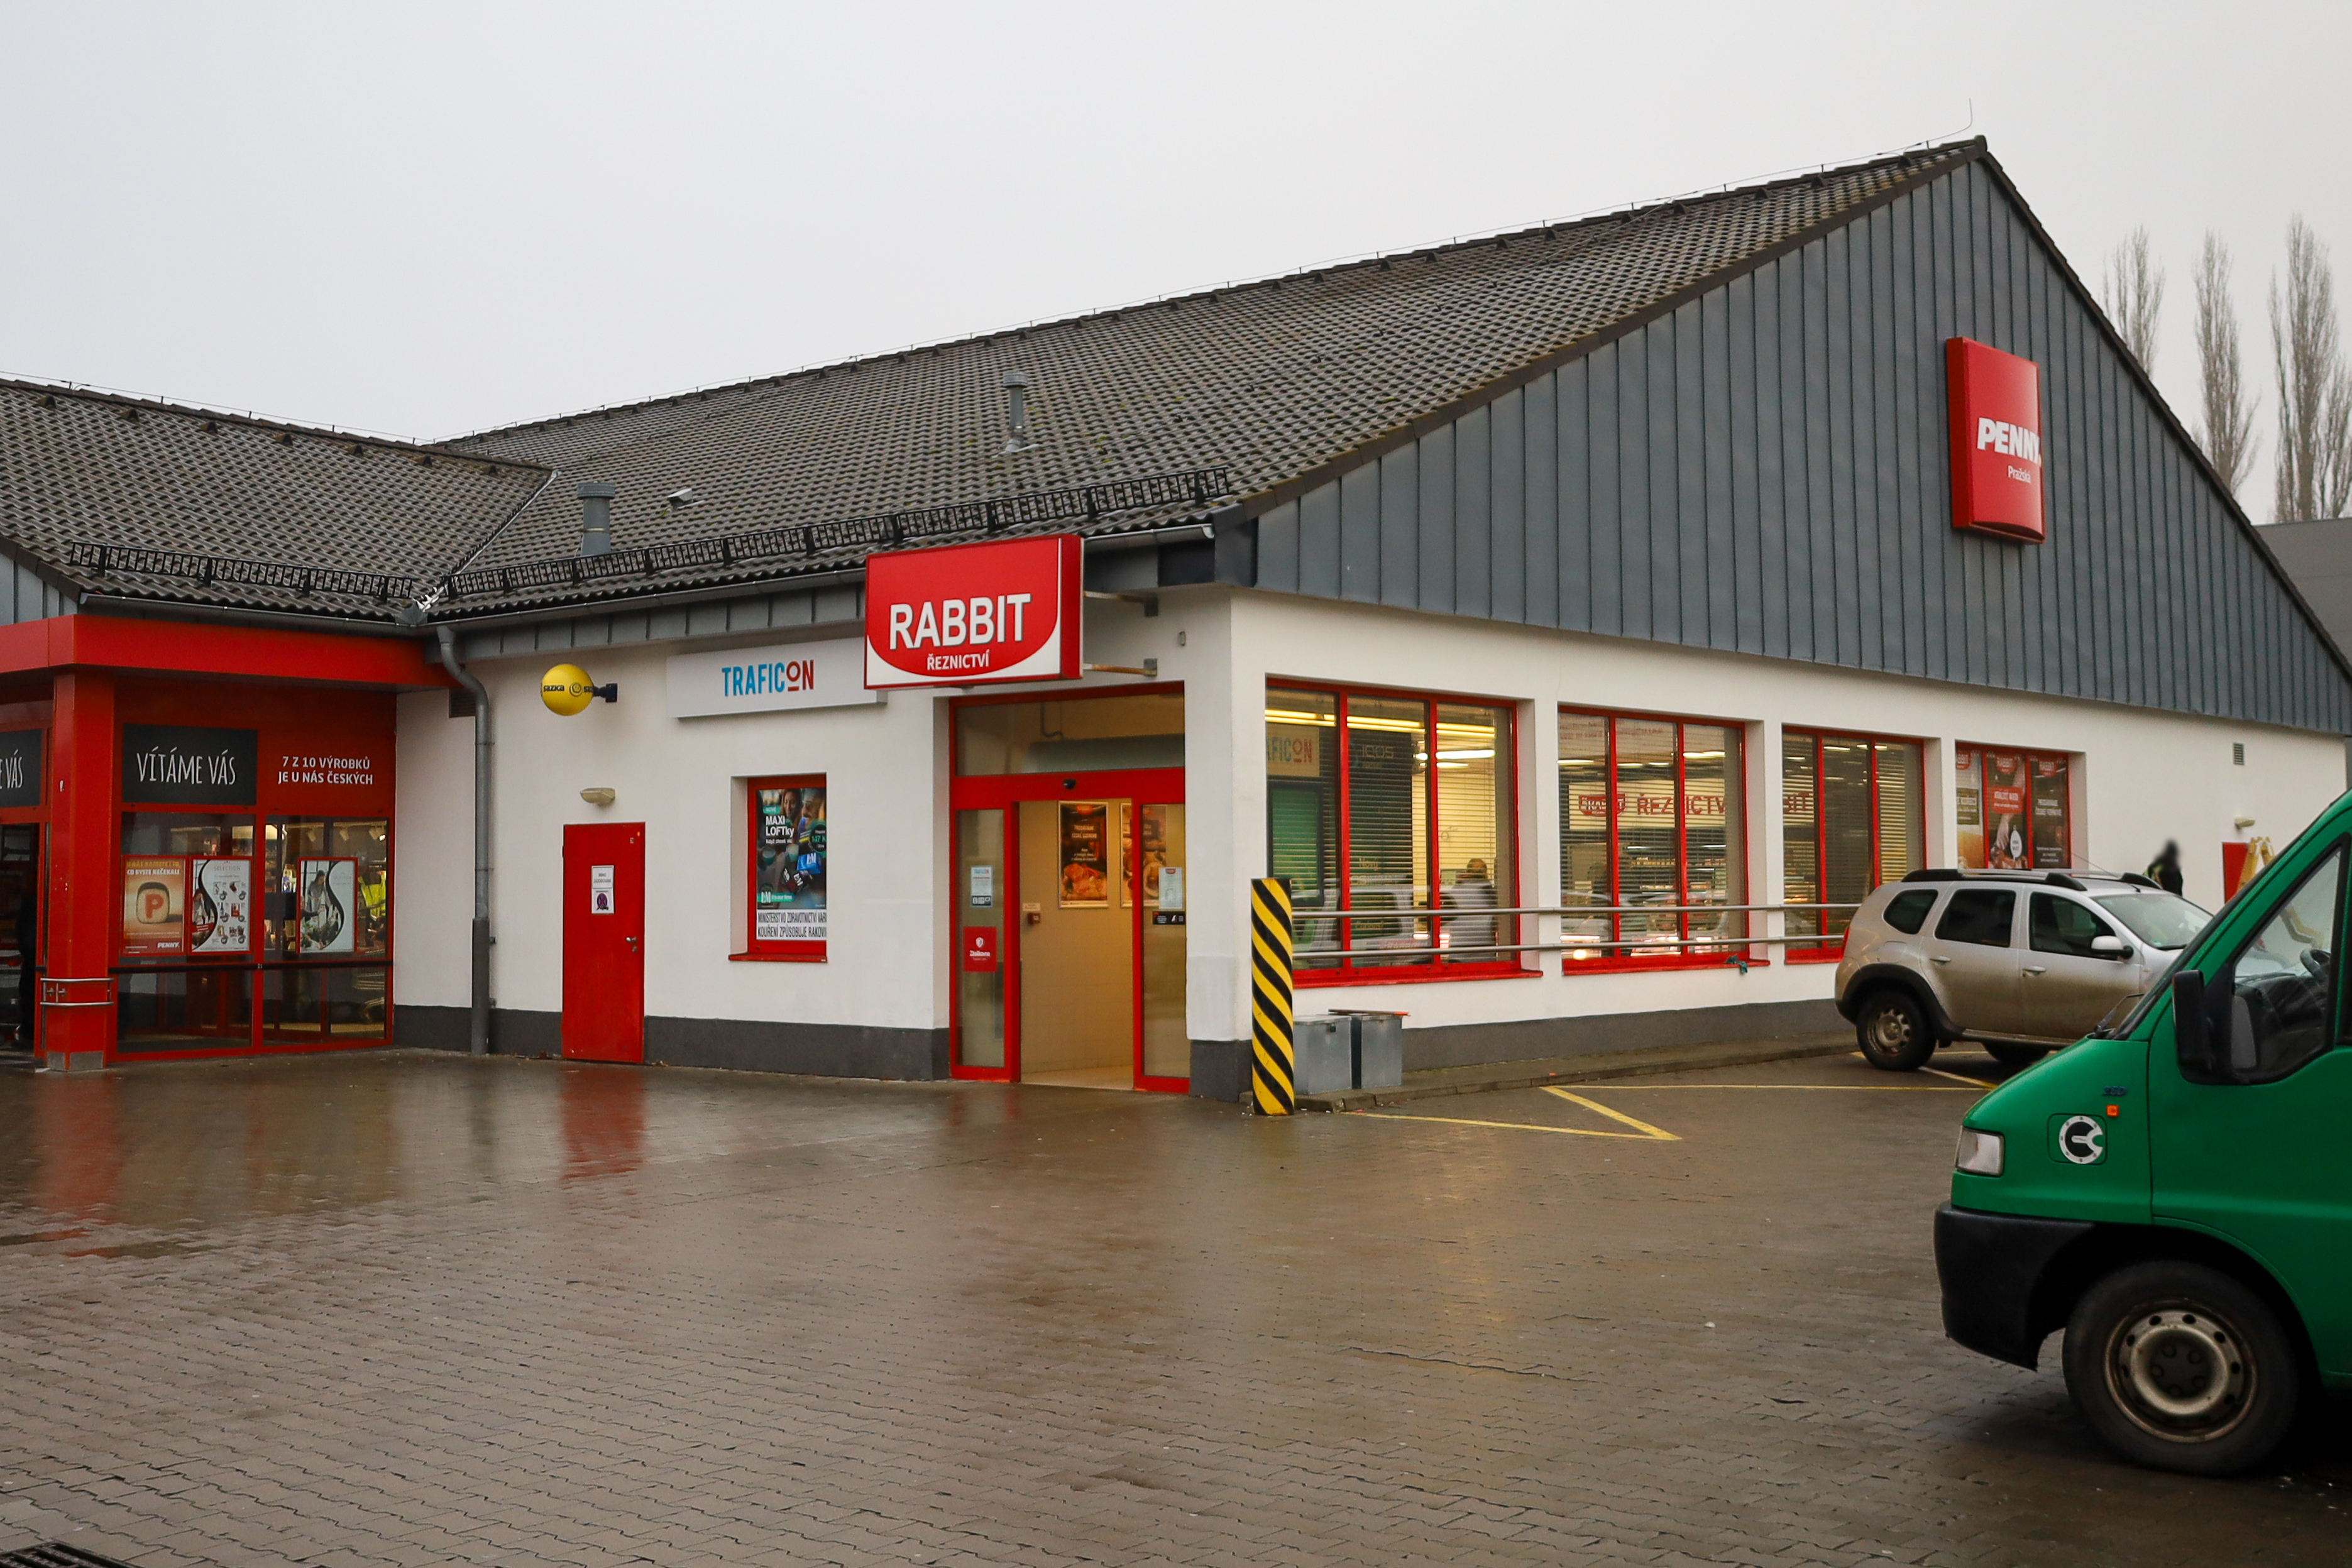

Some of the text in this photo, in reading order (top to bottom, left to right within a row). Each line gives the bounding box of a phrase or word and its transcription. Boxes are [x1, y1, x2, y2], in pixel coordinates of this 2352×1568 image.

[2007, 464, 2031, 483] Pražská
[889, 593, 1031, 650] RABBIT
[927, 649, 990, 670] ŘEZNICTVÍ
[722, 659, 814, 697] TRAFICON
[5, 749, 23, 788] VÁS
[136, 746, 236, 785] VÍTÁME VÁS
[283, 755, 370, 770] 7 Z 10 VÝROBKŮ
[278, 770, 373, 785] JE U NÁS ČESKÝCH
[765, 815, 786, 826] MAXI
[765, 826, 794, 838] LOFTky
[758, 912, 786, 923] MINISTERSTVO
[787, 910, 818, 923] ZDRAVOTNICTVÍ
[758, 924, 779, 938] KOUŘENÍ
[779, 924, 807, 938] ZPŮSOBUJE
